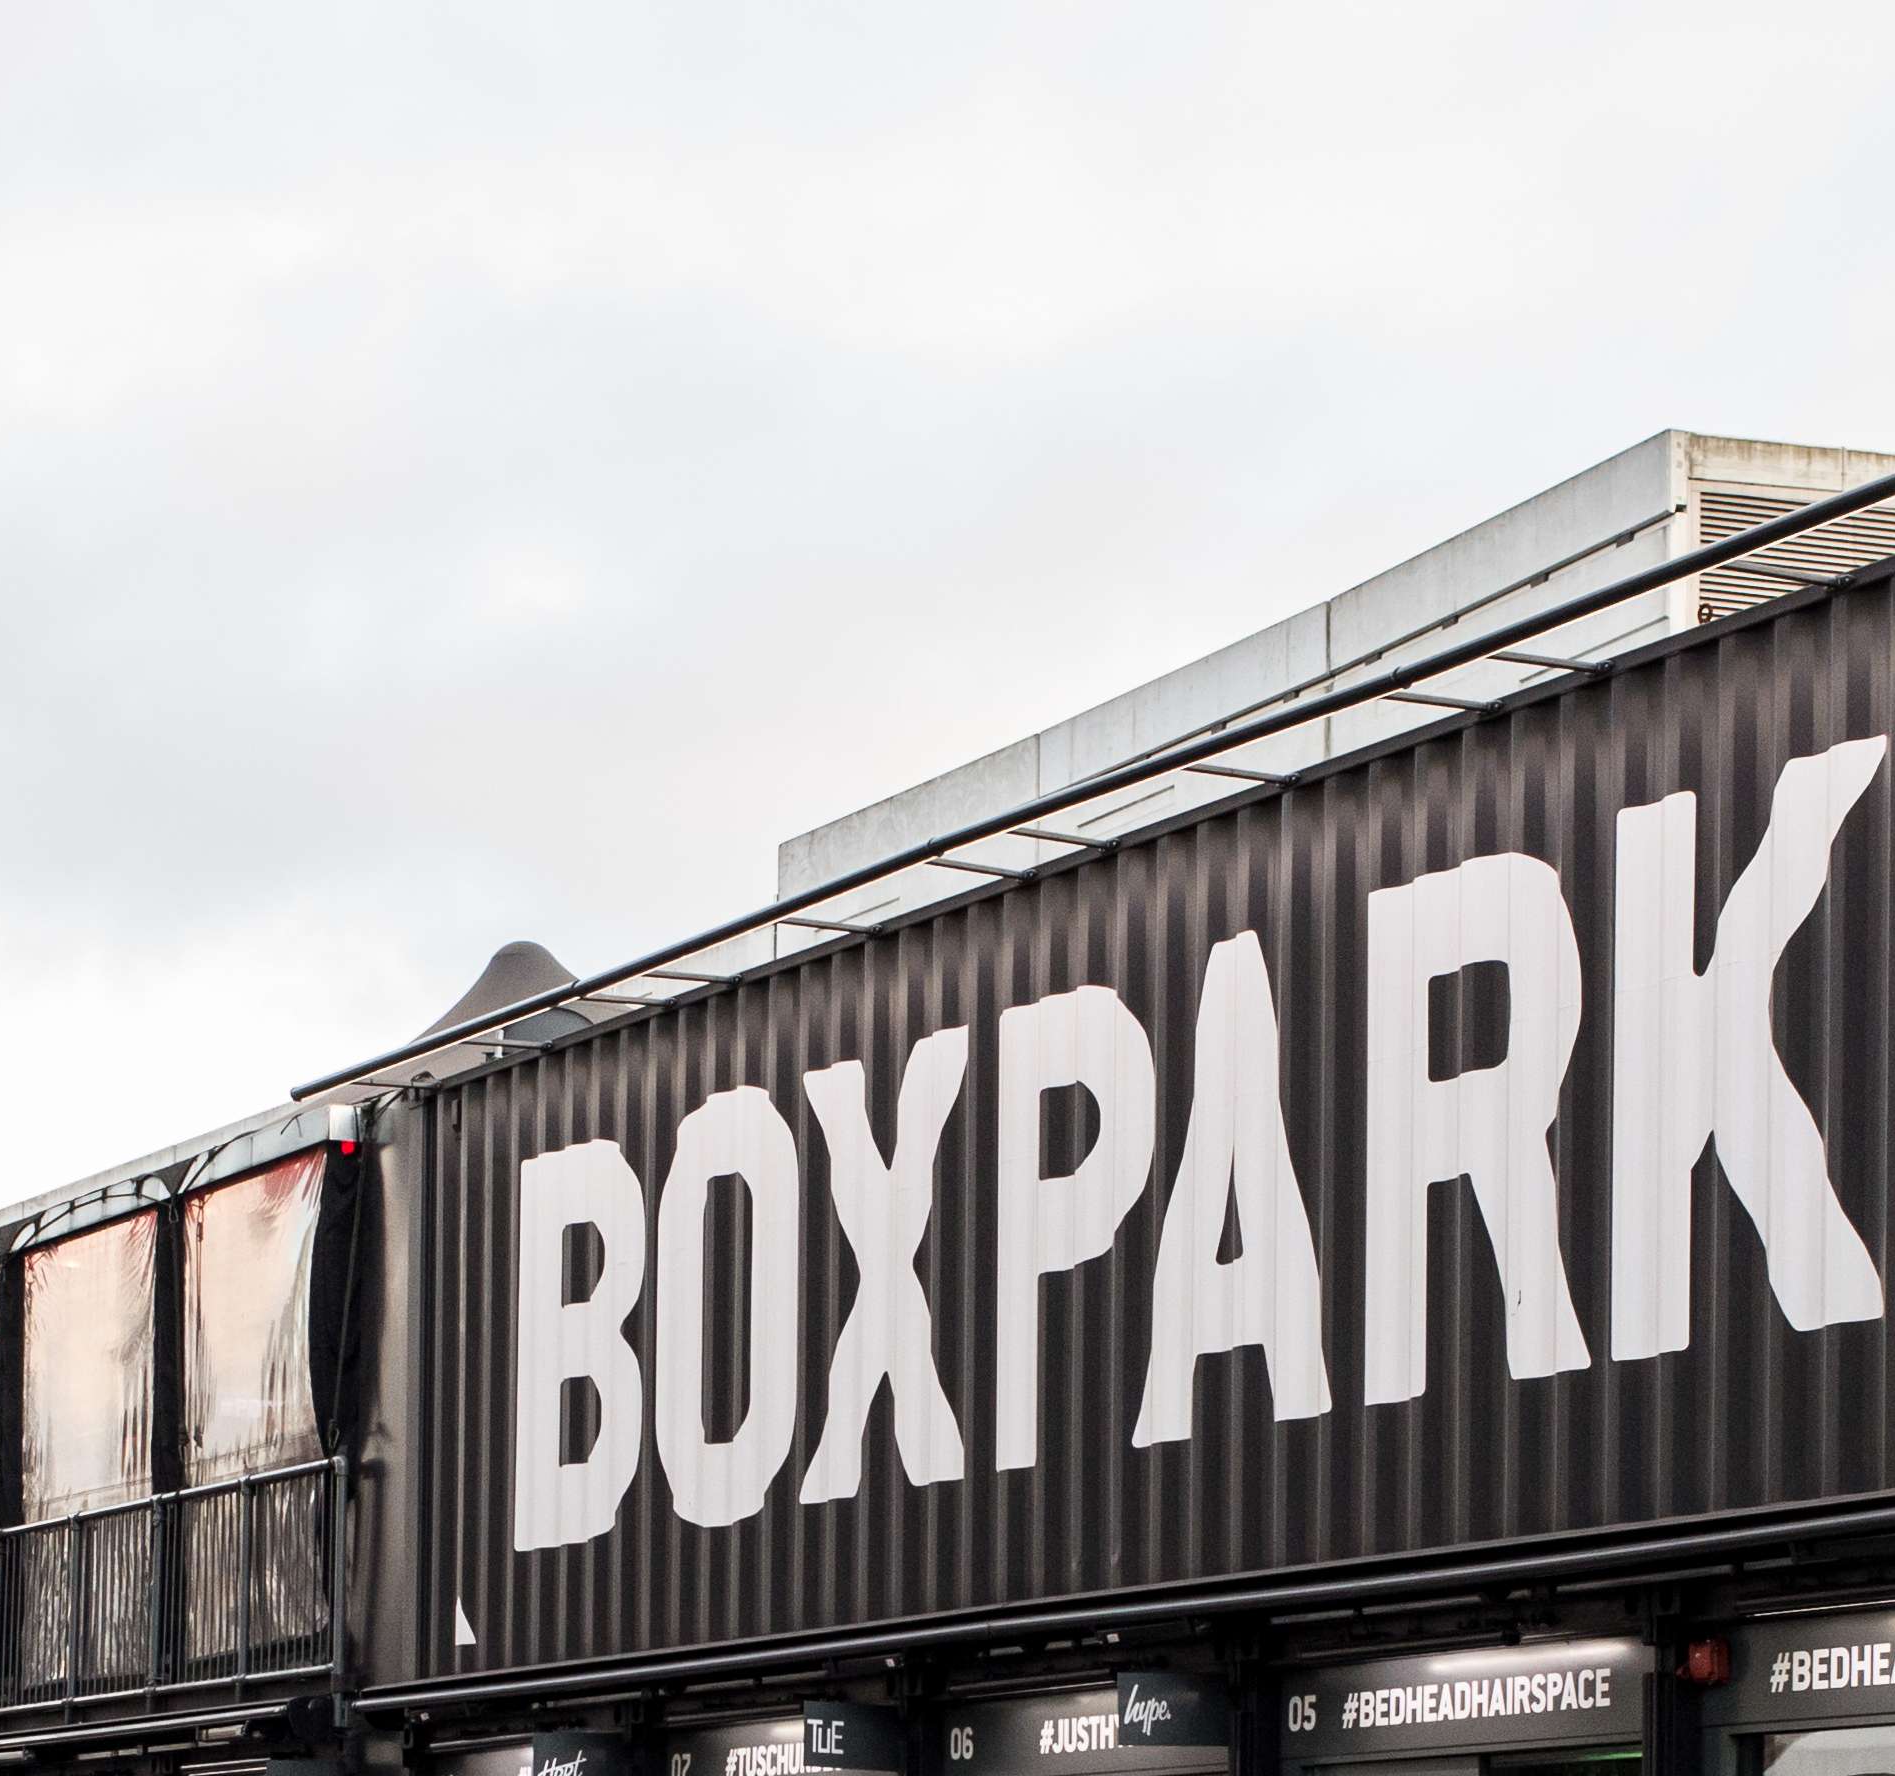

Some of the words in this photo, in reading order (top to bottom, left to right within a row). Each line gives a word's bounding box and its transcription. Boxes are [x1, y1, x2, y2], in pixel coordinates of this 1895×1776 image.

[512, 733, 1889, 1553] BOXPARK
[1124, 1684, 1171, 1736] hype.
[1288, 1694, 1317, 1732] 05
[1341, 1667, 1611, 1730] #BEDHEADHAIRSPACE
[950, 1726, 973, 1760] 06
